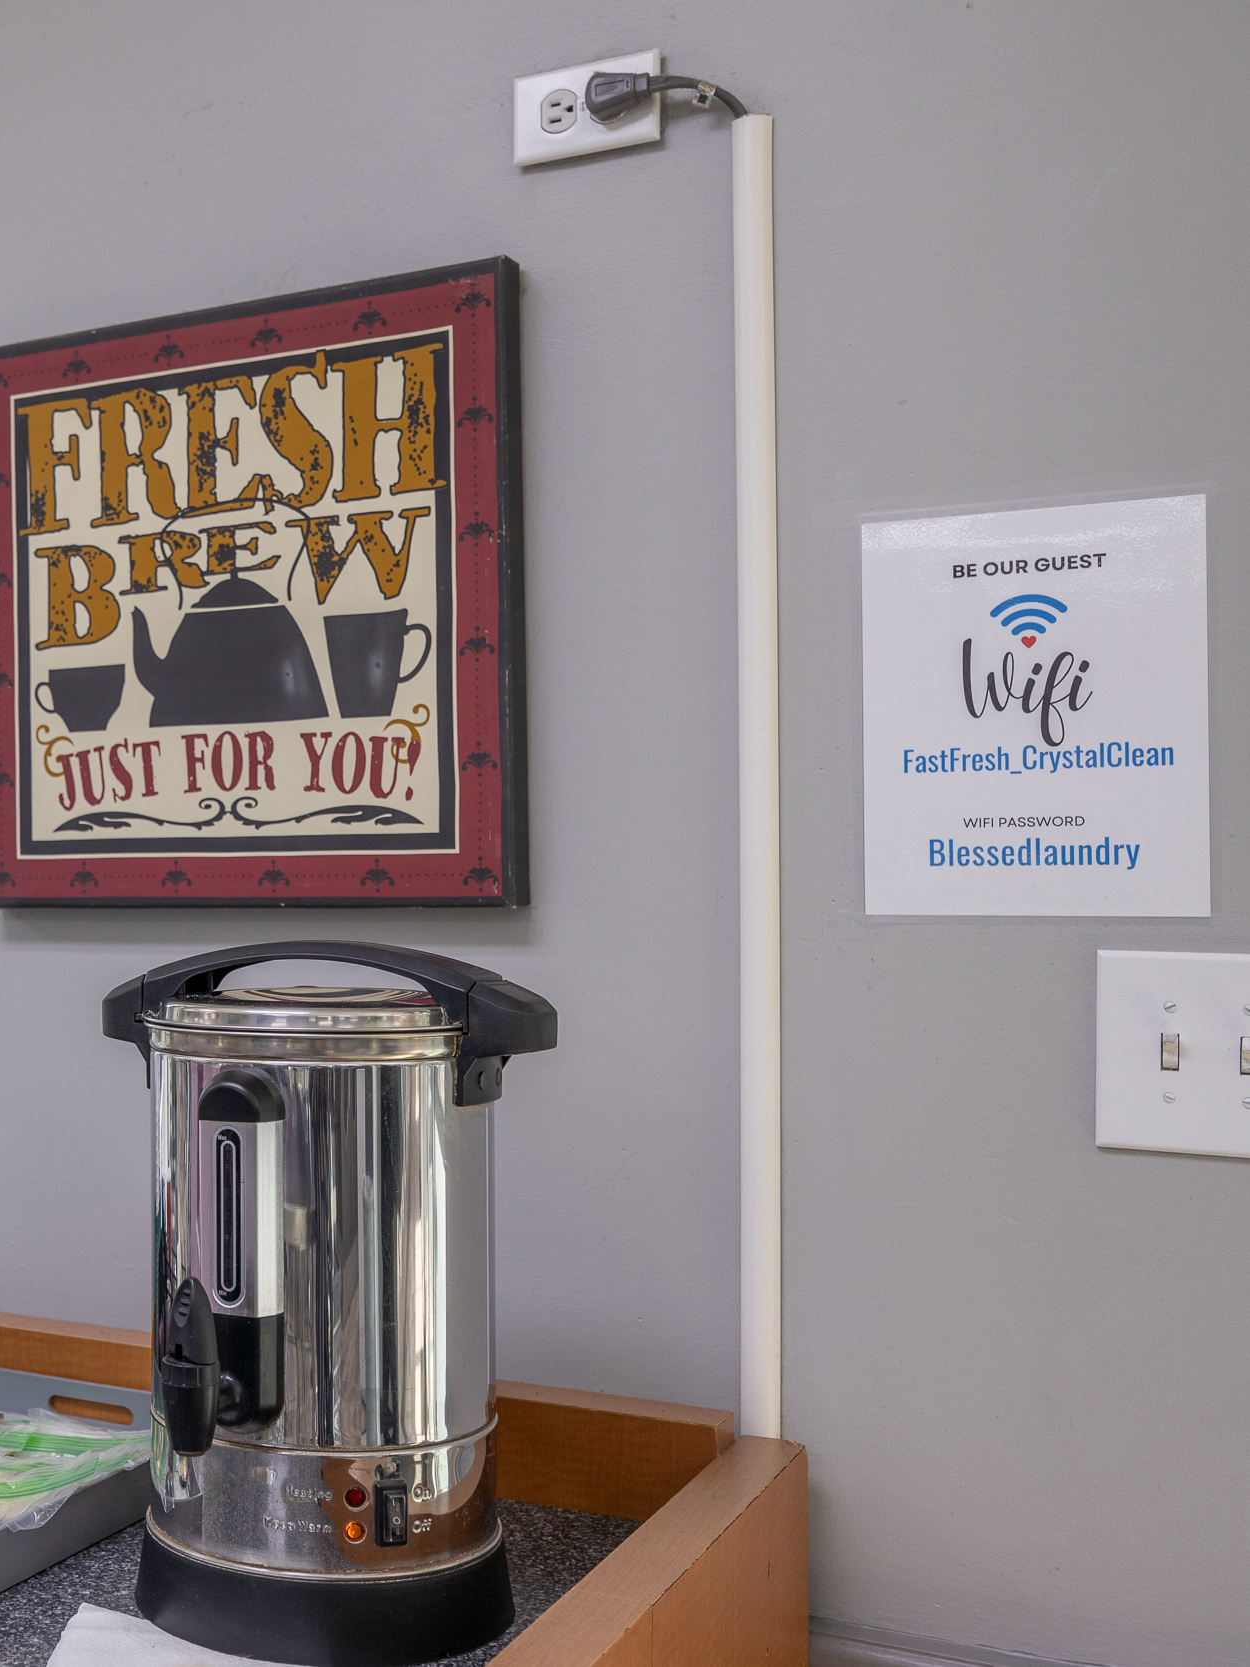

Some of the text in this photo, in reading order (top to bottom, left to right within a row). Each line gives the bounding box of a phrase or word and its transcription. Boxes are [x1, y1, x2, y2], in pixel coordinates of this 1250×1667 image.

[18, 343, 447, 535] FRESH
[34, 506, 430, 651] BREW
[952, 553, 1107, 579] BE OUR GUEST
[962, 638, 1094, 747] Wifi
[58, 730, 421, 811] JUST FOR YOU!
[903, 741, 1175, 775] FastFresh_CrystalClean
[963, 815, 1085, 829] WIFI PASSWORD
[929, 836, 1141, 871] Blessedlaundry
[412, 1485, 433, 1502] On
